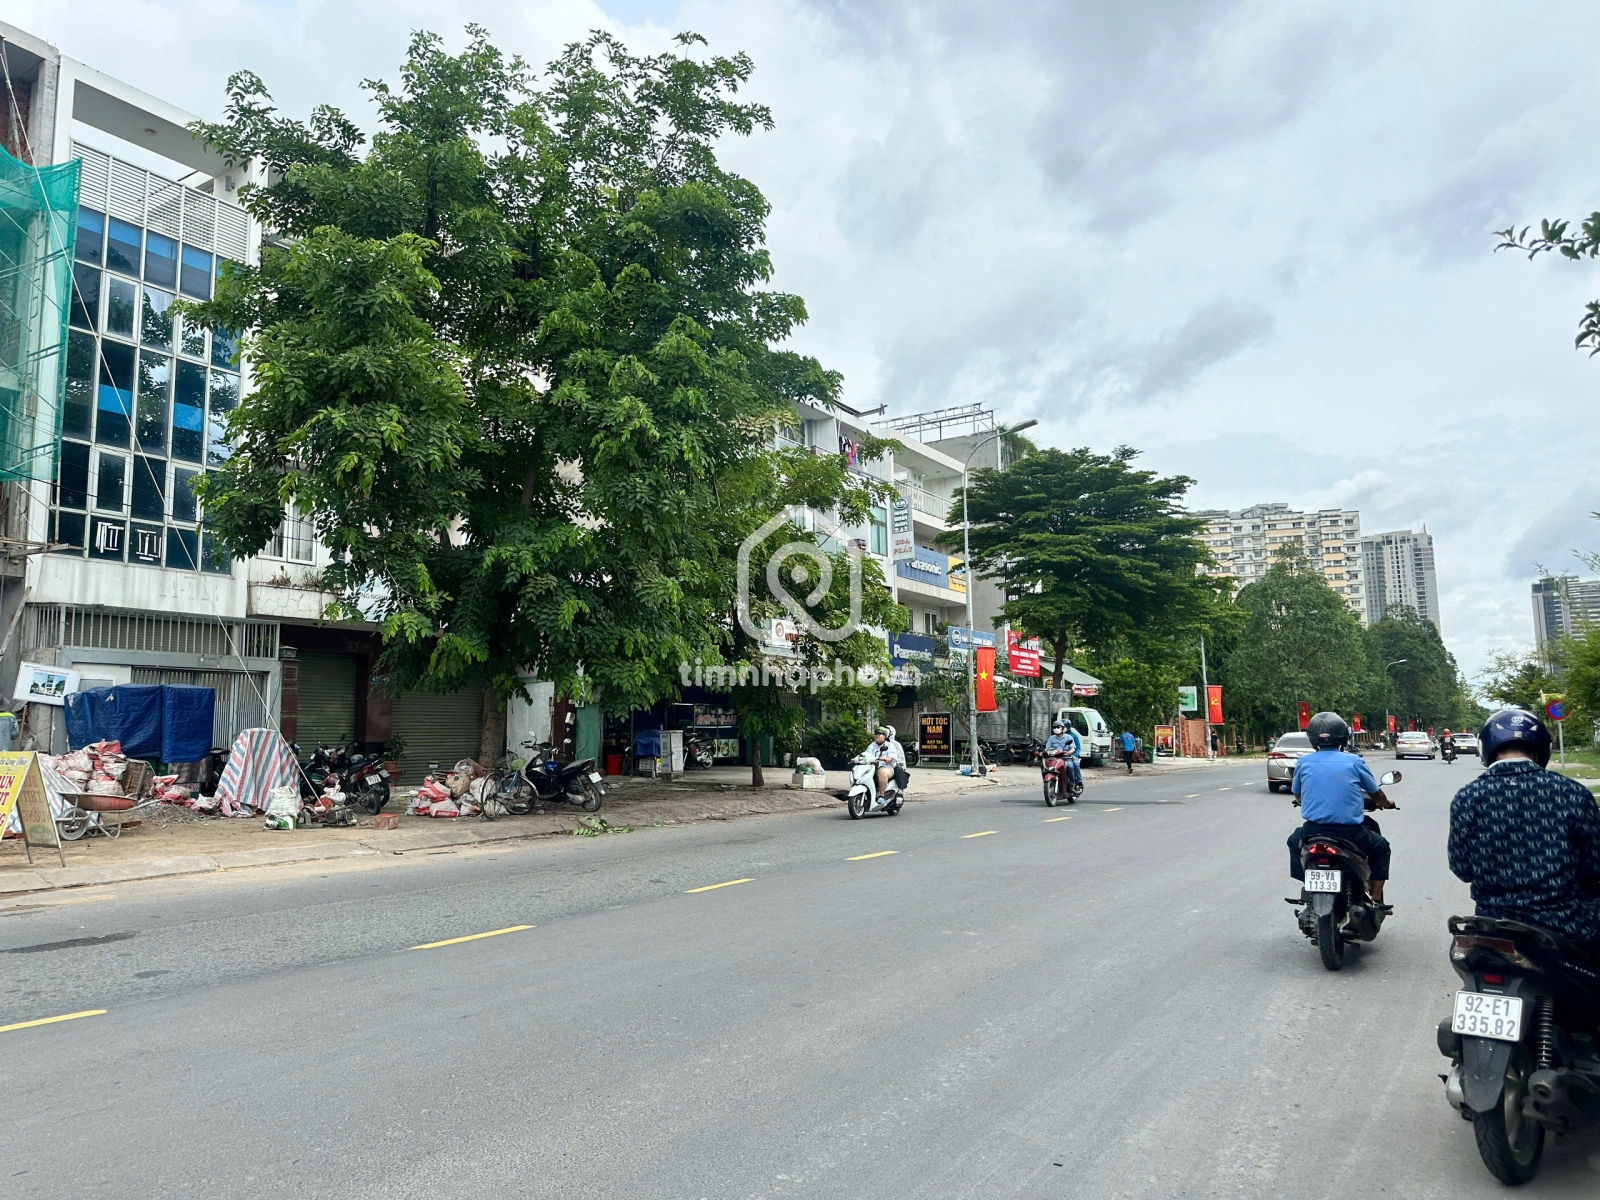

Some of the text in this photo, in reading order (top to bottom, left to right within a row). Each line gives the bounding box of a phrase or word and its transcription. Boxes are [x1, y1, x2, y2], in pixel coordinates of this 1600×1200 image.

[922, 716, 948, 725] HỚT TÓC
[1555, 784, 1567, 792] NY
[1310, 871, 1335, 881] 59-VA
[1309, 881, 1338, 890] 113.39
[1465, 995, 1510, 1016] 92-E1
[1457, 1014, 1516, 1038] 335.82
